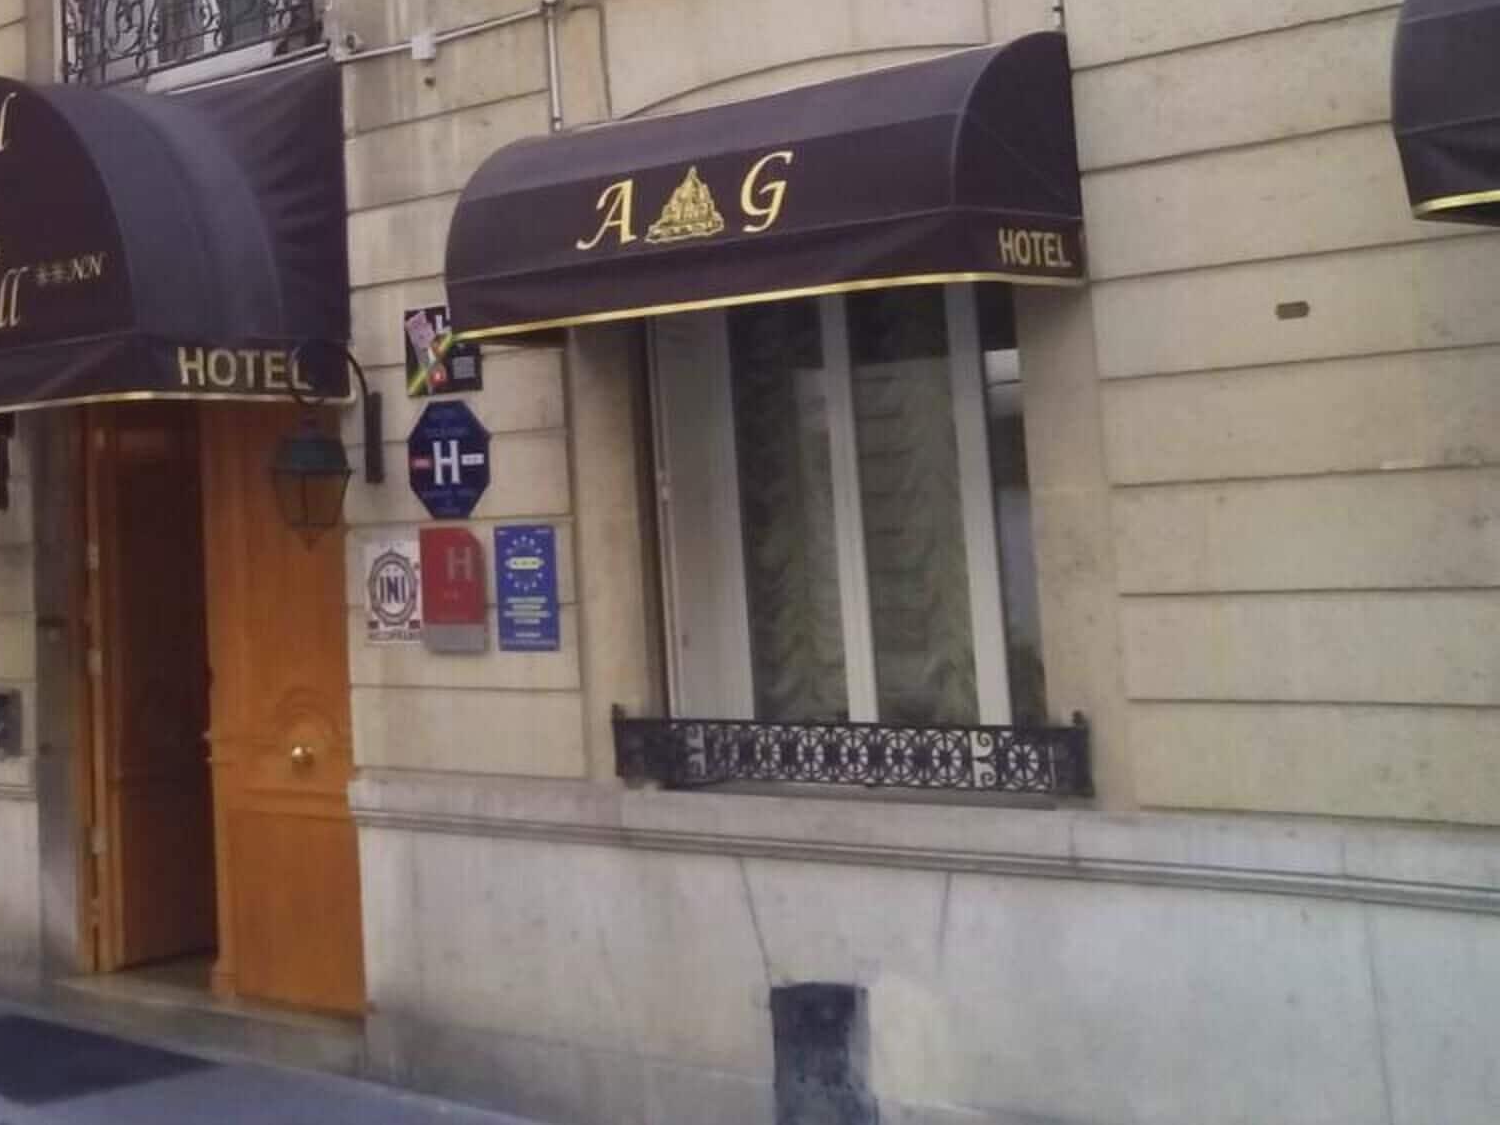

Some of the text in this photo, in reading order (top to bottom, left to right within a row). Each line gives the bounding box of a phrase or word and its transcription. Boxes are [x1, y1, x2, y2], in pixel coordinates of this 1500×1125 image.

[576, 149, 795, 251] A G
[998, 228, 1073, 268] HOTEL
[177, 345, 314, 391] HOTEL
[432, 439, 461, 486] H
